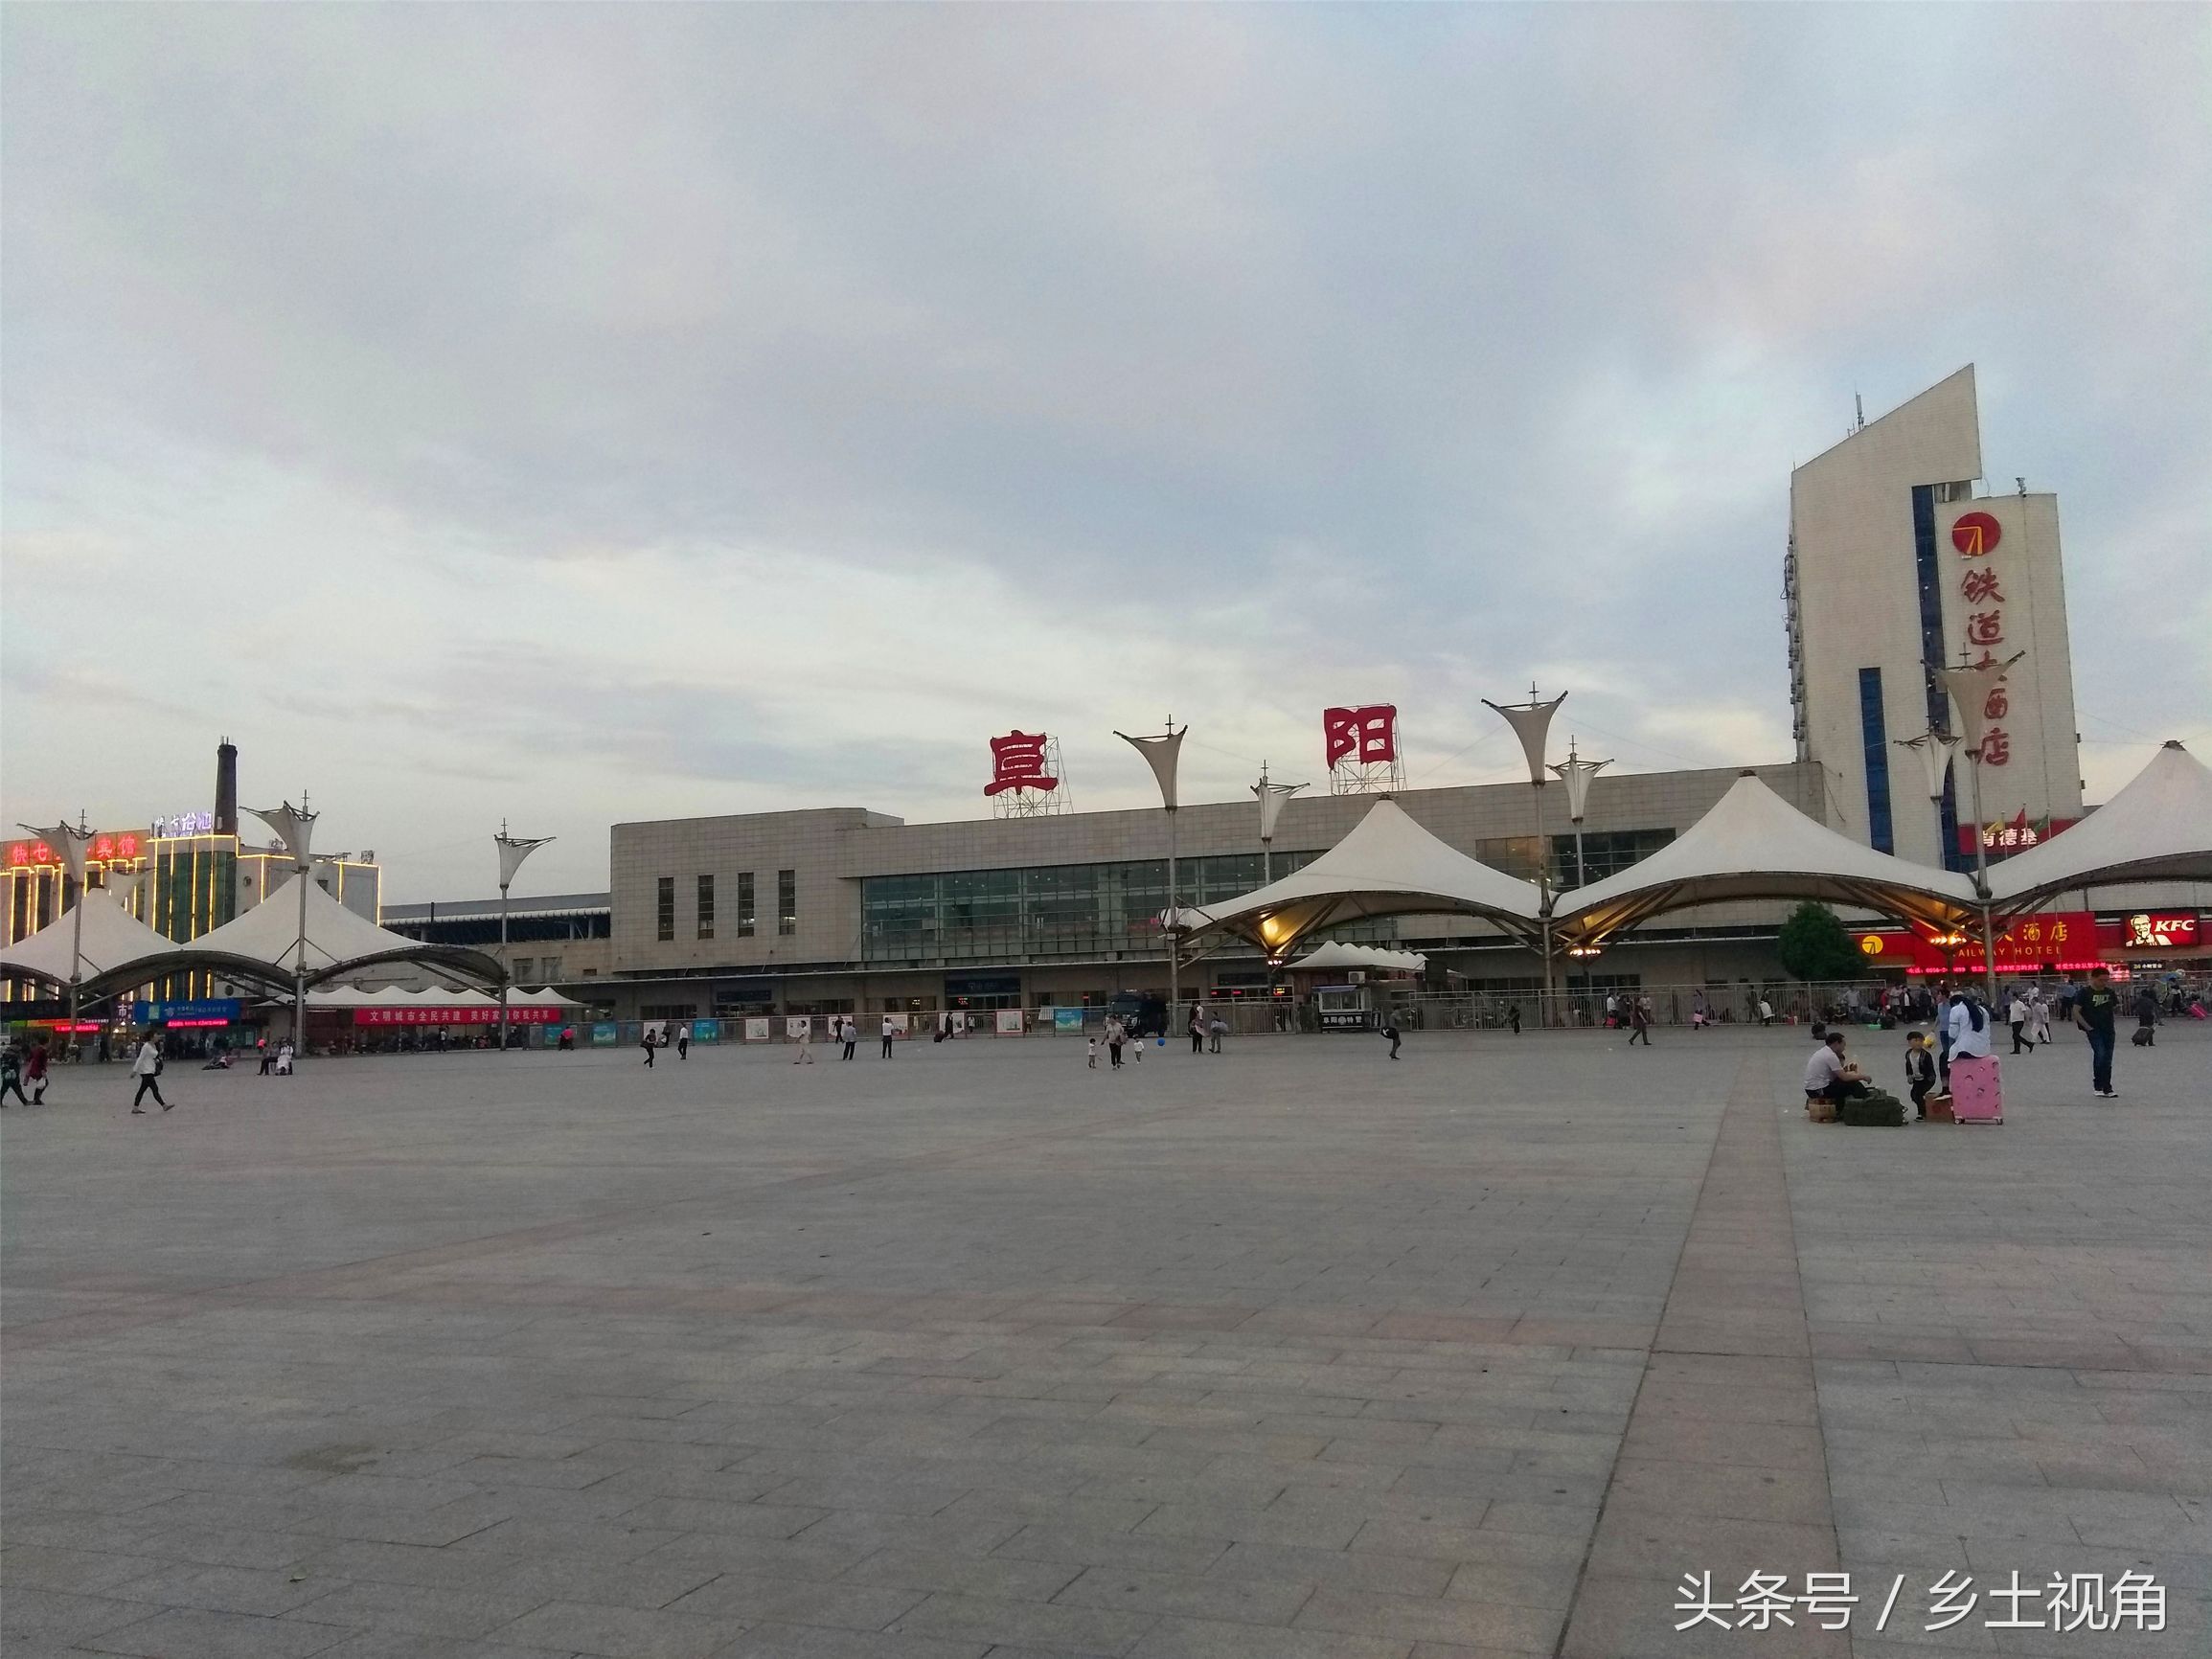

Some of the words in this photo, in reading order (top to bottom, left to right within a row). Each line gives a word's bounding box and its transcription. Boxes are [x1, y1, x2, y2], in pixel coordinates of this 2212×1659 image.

[1982, 827, 2038, 848] 肯德基
[12, 834, 137, 865] 快七宾馆
[2155, 919, 2196, 932] KFC
[1953, 947, 2005, 958] AILWY
[2015, 946, 2061, 956] HOTEL
[370, 1011, 461, 1022] 文明城市全民共建
